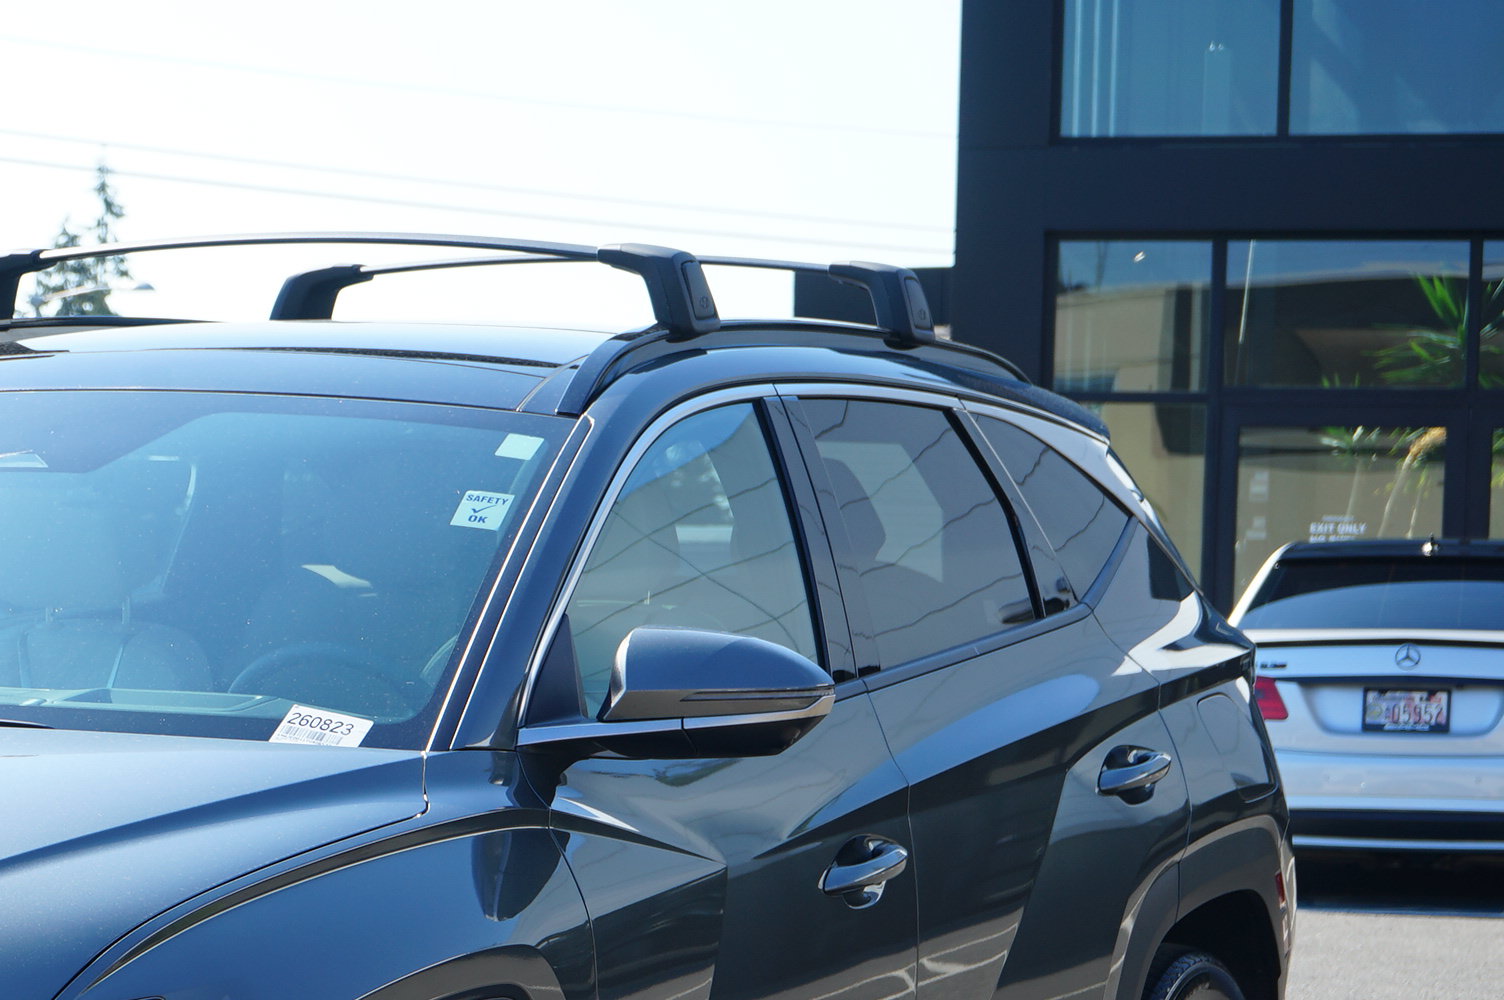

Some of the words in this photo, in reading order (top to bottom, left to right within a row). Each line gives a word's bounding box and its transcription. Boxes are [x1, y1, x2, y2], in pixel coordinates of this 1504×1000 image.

[466, 494, 509, 506] SAFETY
[468, 514, 488, 524] OK
[286, 712, 355, 736] 260823
